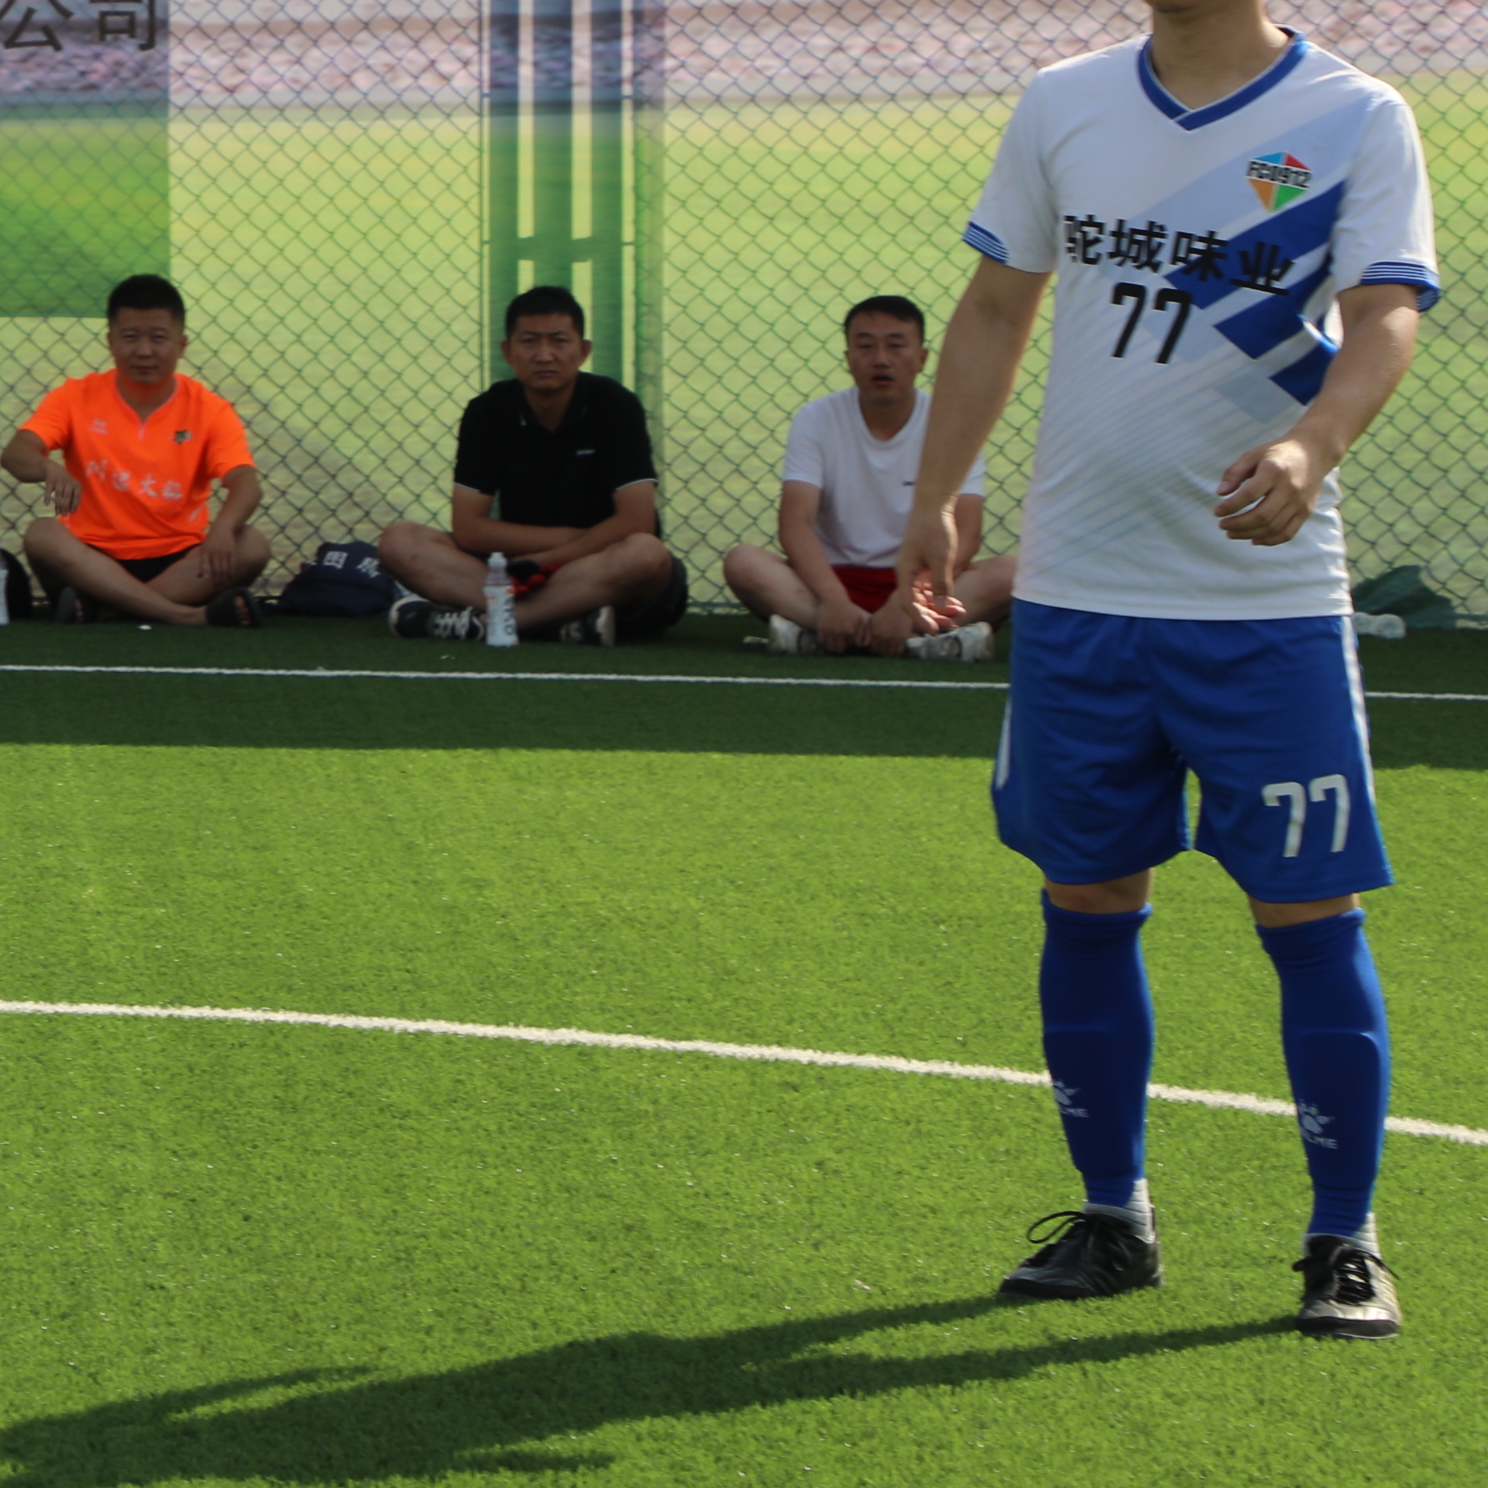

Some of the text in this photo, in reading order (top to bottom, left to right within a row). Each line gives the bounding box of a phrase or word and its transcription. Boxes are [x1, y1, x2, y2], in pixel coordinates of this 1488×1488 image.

[1063, 214, 1296, 296] 驼城味业
[1110, 281, 1193, 365] 77
[1261, 773, 1351, 858] 77
